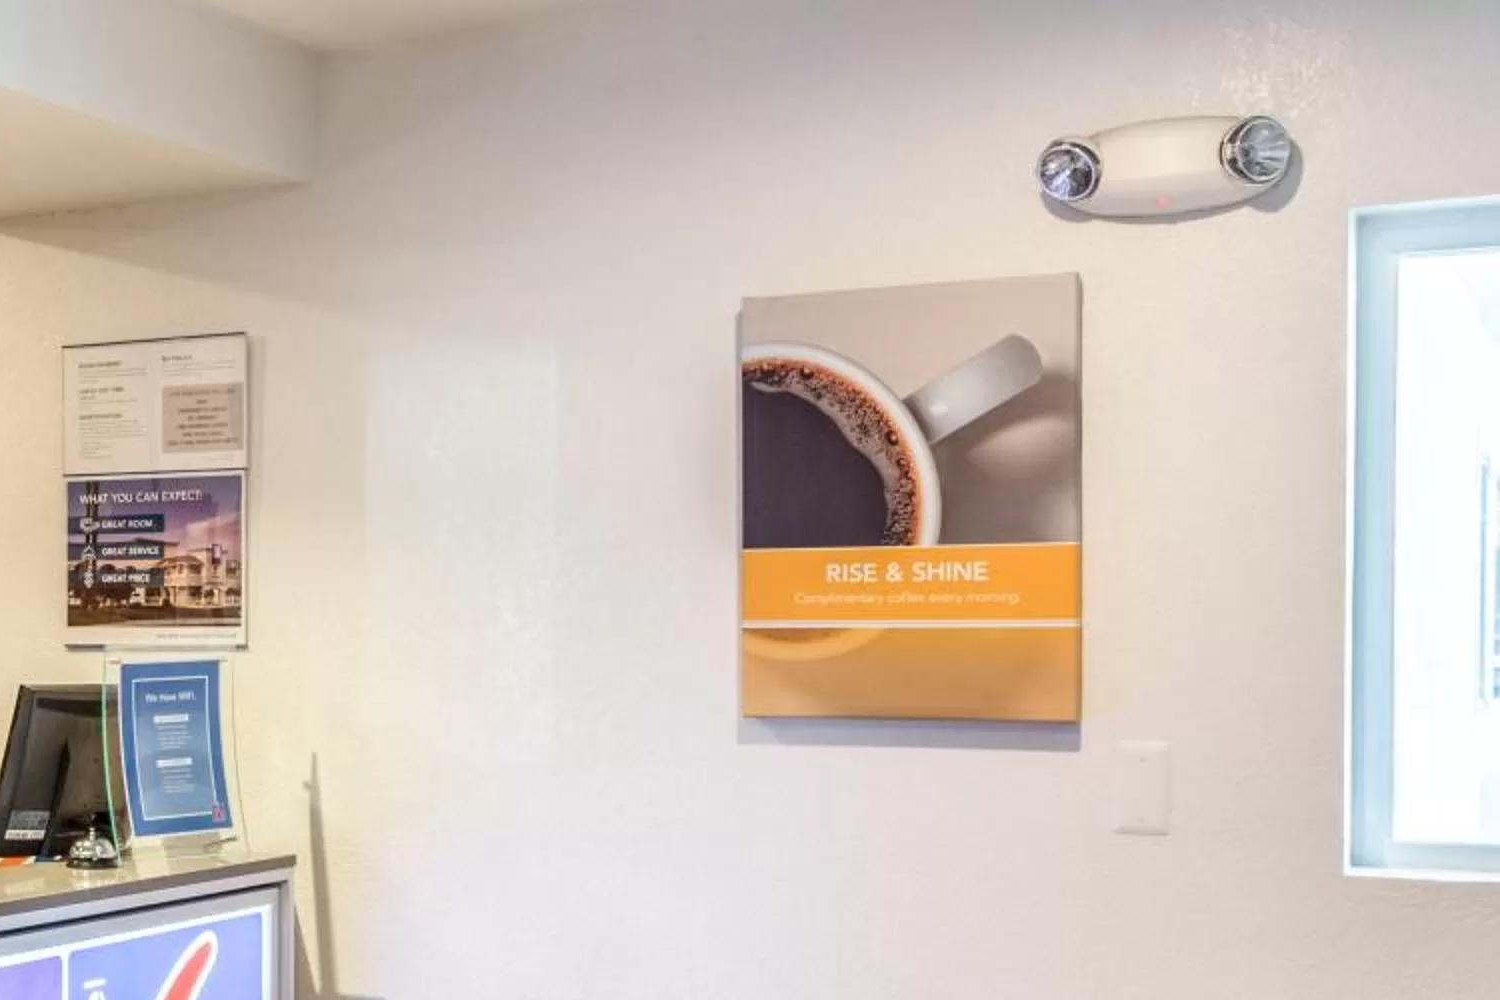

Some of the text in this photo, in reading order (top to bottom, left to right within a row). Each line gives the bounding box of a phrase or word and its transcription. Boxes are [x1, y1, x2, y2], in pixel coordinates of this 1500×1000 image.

[80, 493, 108, 505] WHAT
[112, 492, 132, 503] YOU
[135, 491, 158, 502] CAN
[101, 519, 153, 529] GREAT ROOM
[101, 546, 160, 556] GREAT SERVICE
[826, 560, 989, 584] RISE & SHINE
[101, 573, 151, 583] GREAT PRICE
